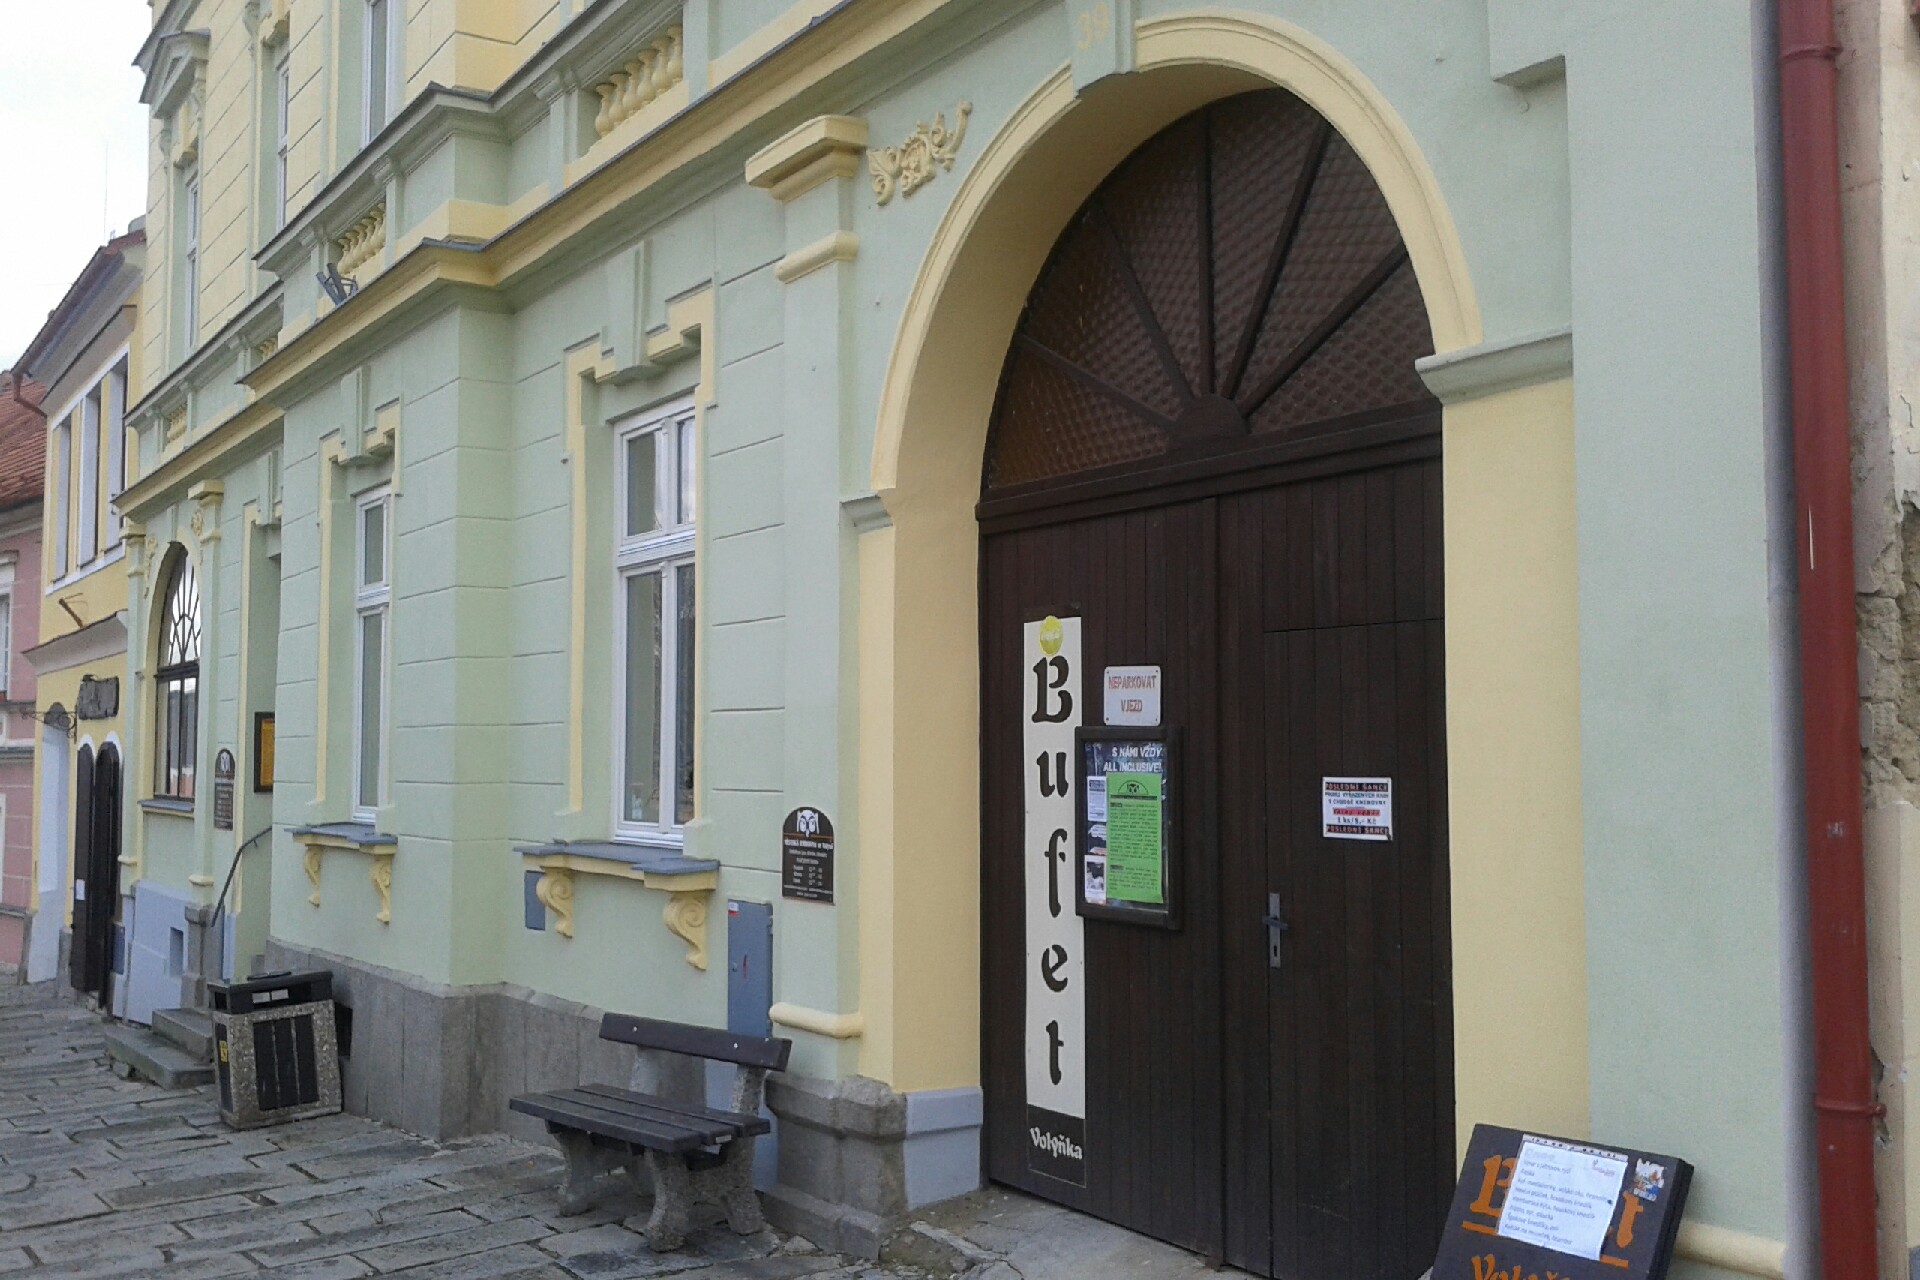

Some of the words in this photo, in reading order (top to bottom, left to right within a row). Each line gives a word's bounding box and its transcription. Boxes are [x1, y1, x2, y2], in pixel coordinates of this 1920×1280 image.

[1109, 675, 1157, 689] NEPARKOVAT
[1121, 699, 1142, 712] VJEZD
[1111, 746, 1118, 757] S
[1119, 744, 1139, 757] NÁMI
[1103, 761, 1117, 772] ALL
[1031, 655, 1073, 1086] Bufet
[1030, 1126, 1083, 1160] Volyňka
